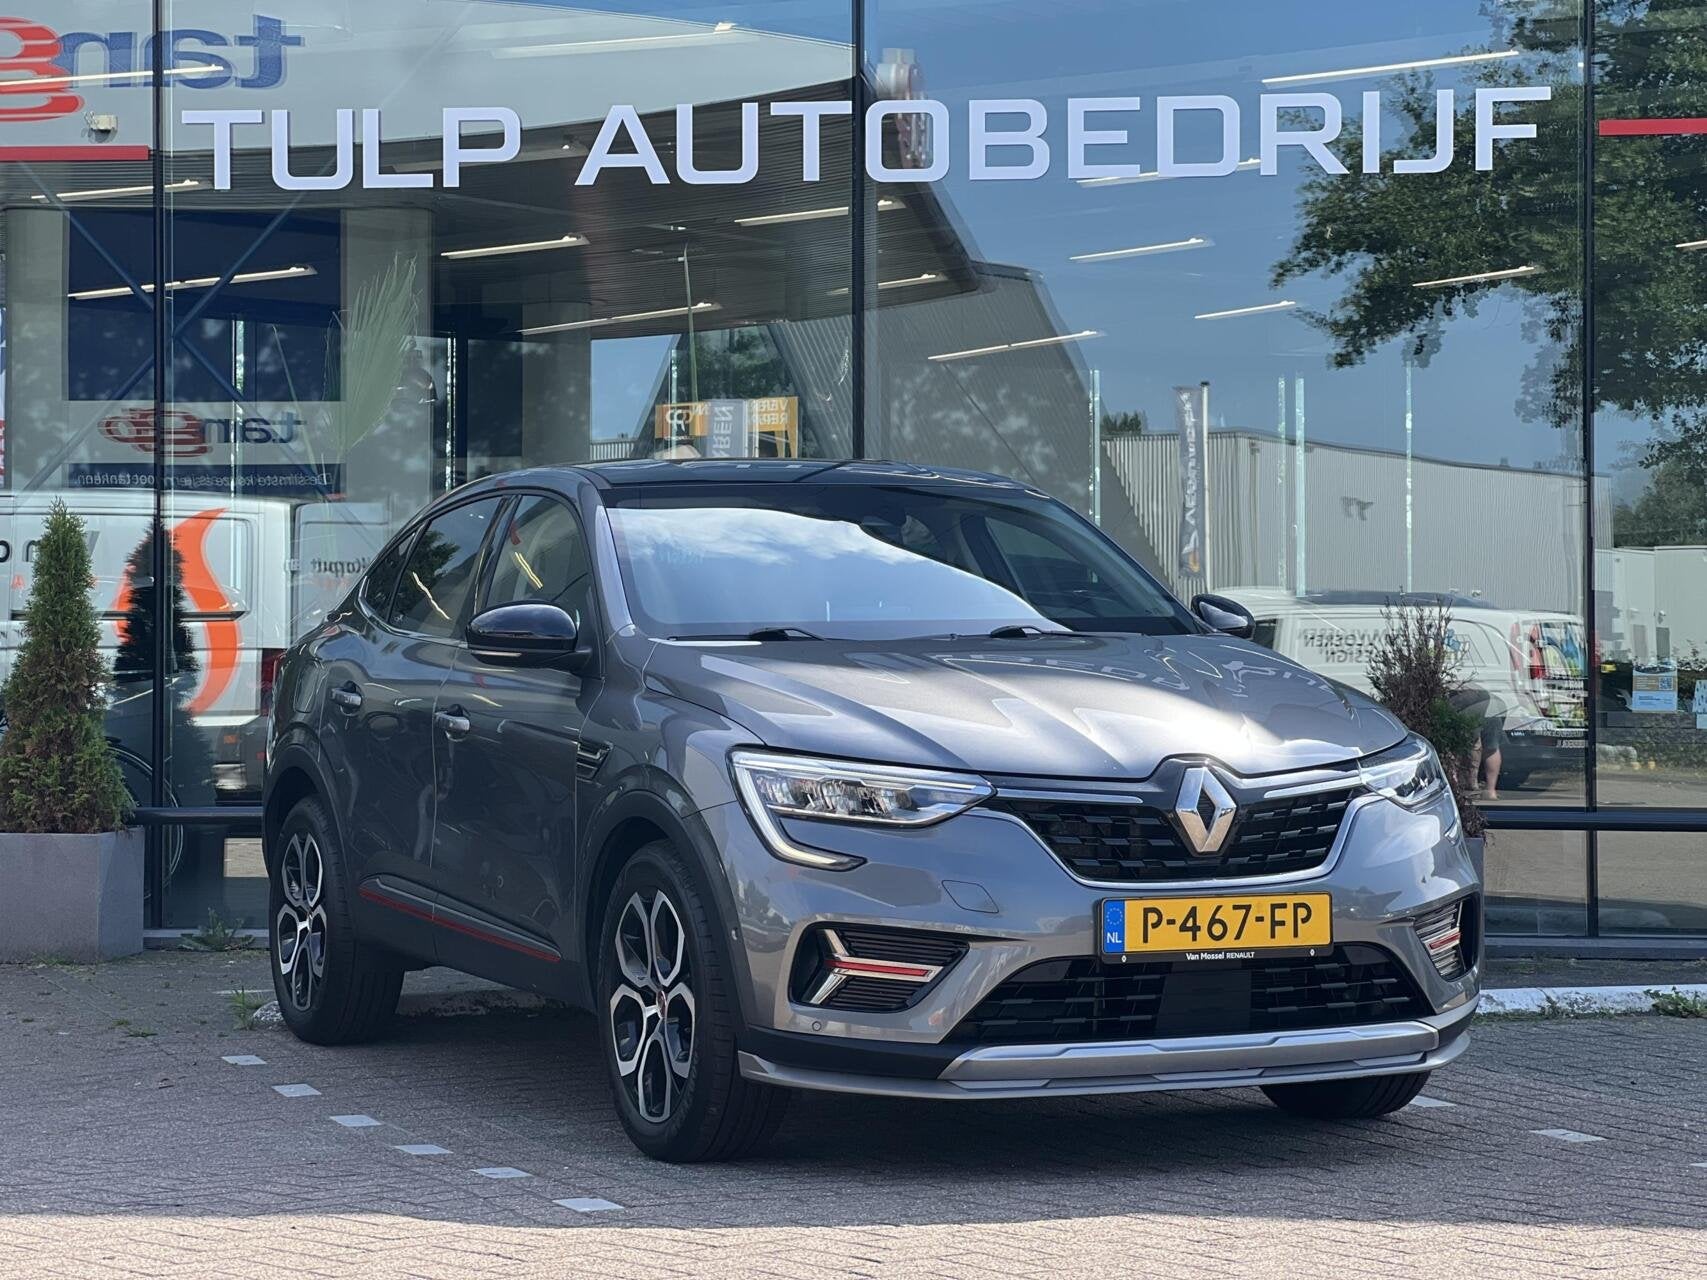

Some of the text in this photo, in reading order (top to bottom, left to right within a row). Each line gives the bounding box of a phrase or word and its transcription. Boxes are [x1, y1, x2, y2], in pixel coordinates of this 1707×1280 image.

[182, 86, 1552, 190] TULP AUTOBEDRIJF
[1142, 901, 1312, 944] P-467-FP
[1106, 931, 1122, 944] NL
[1186, 950, 1255, 960] Van Mossel RENAULT
